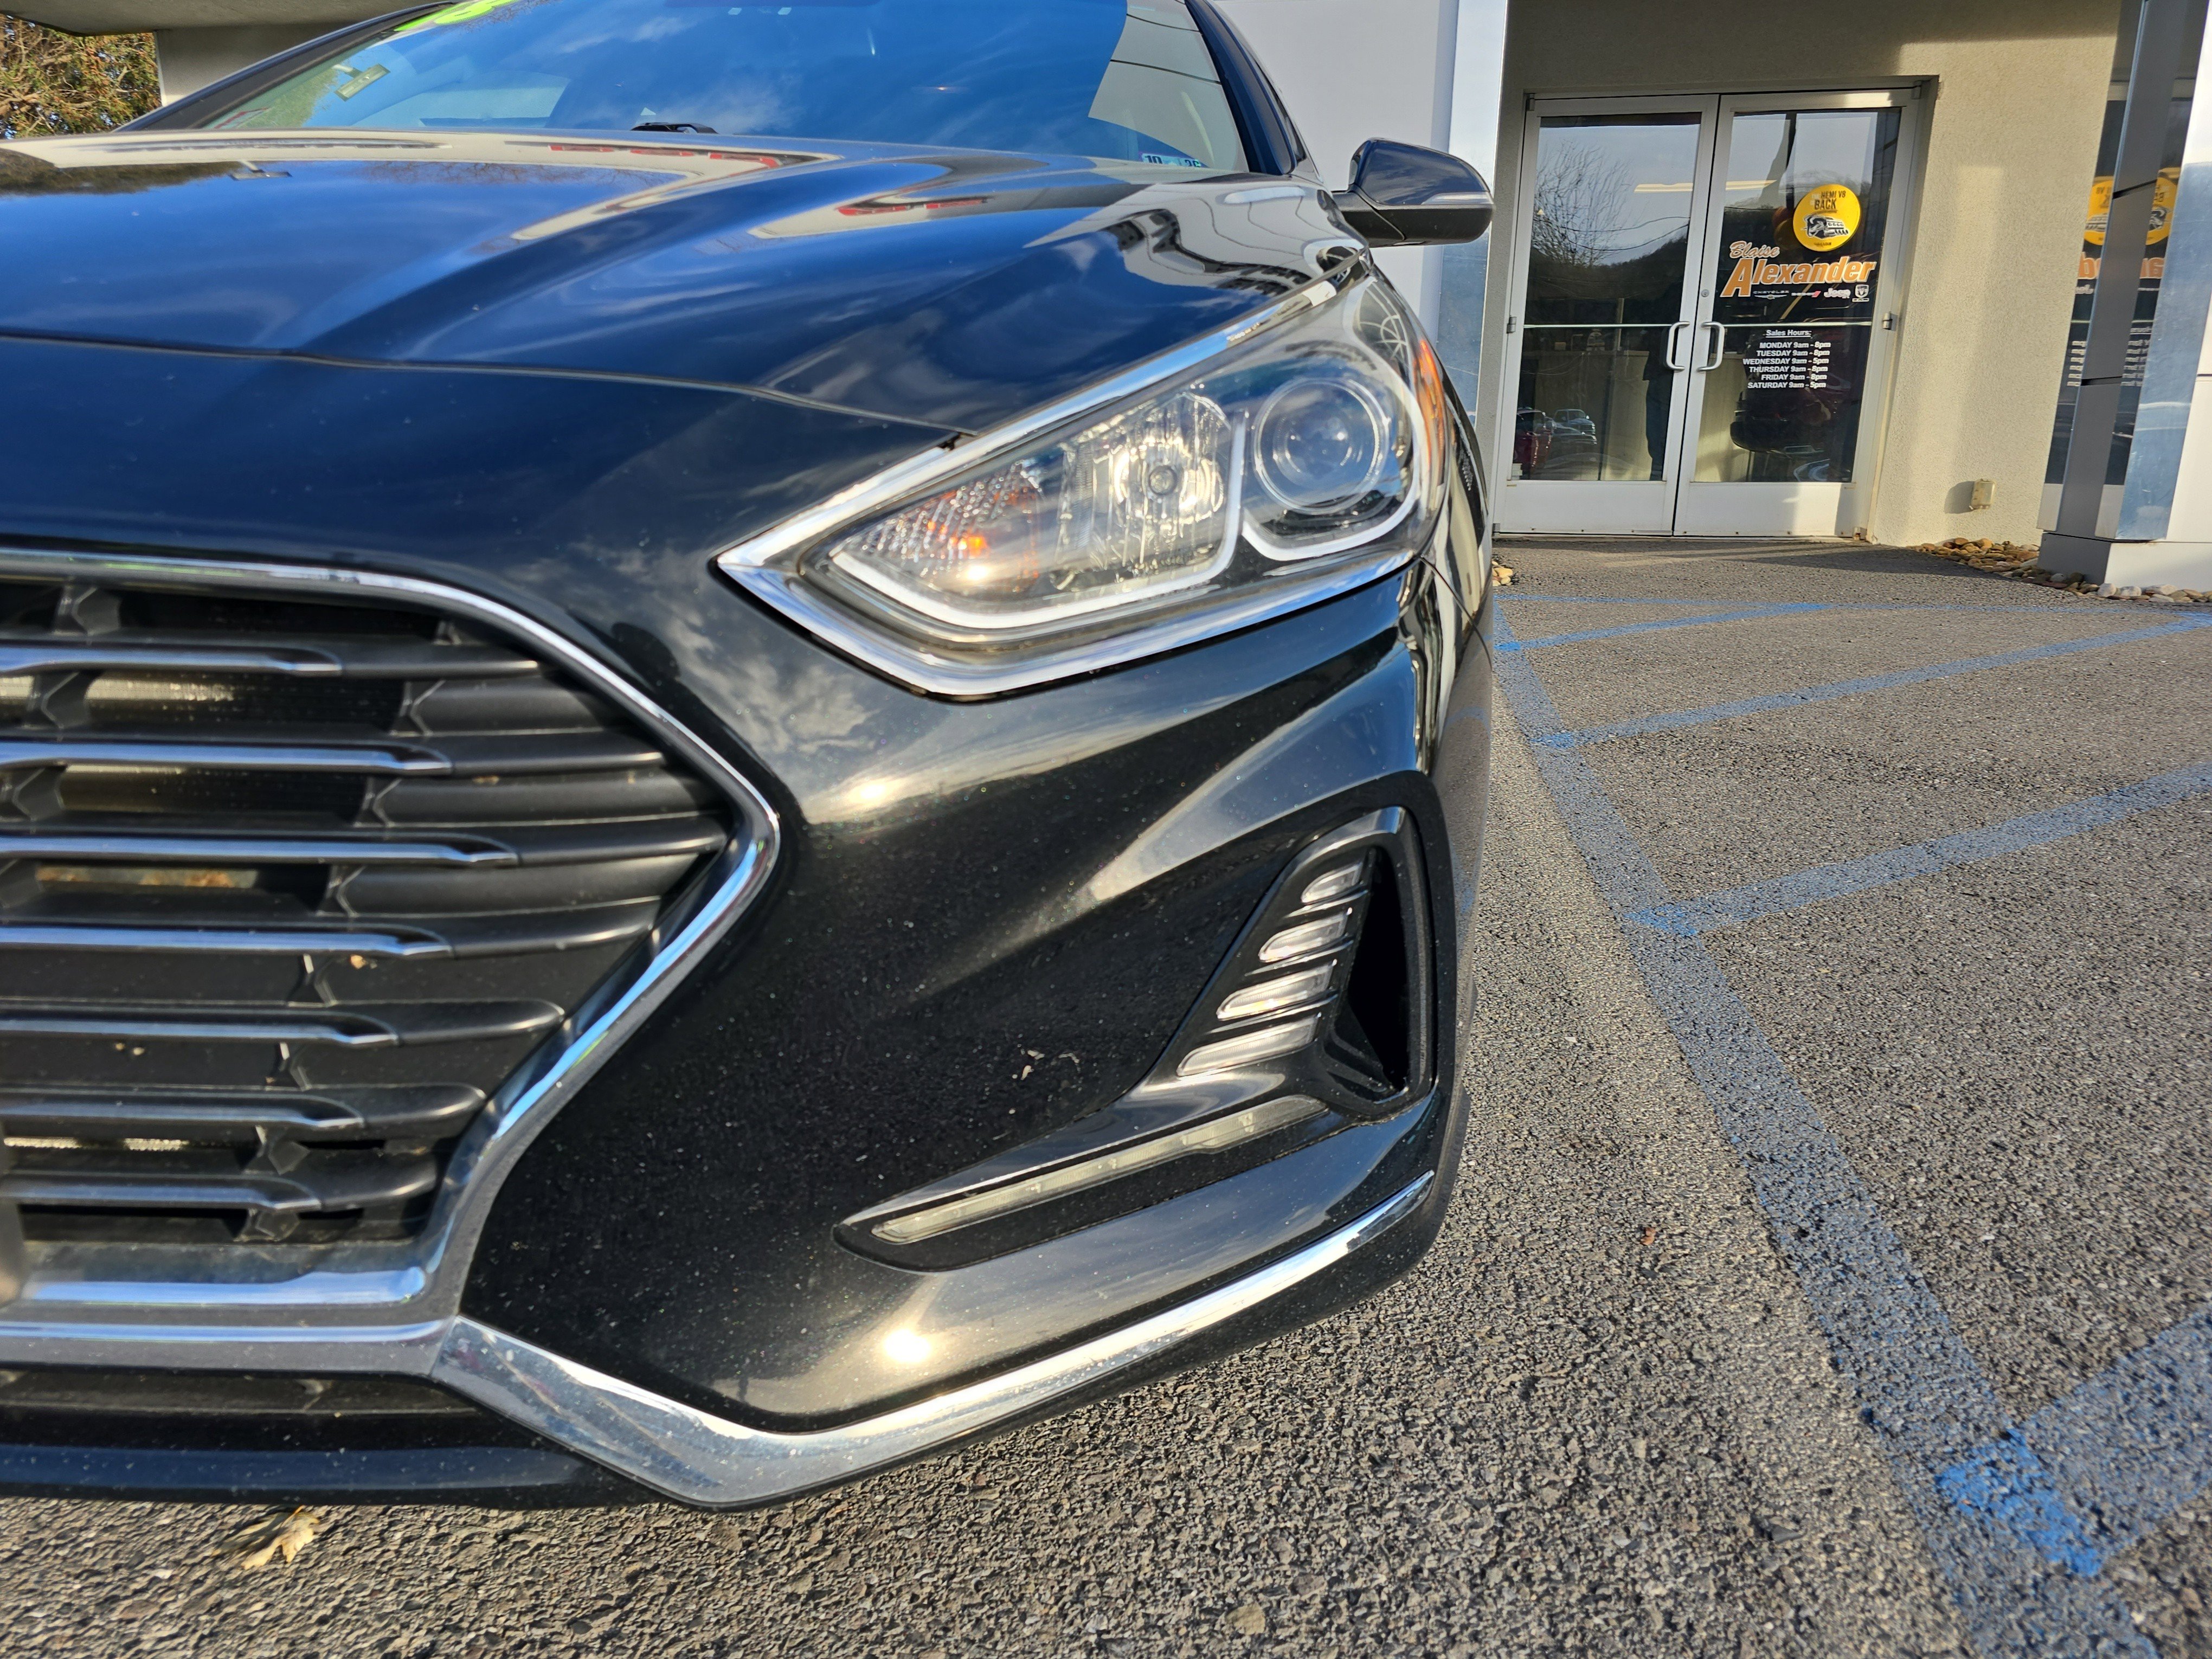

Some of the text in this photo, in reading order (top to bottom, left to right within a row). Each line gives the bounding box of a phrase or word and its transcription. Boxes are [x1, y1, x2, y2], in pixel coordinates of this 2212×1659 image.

[1838, 190, 1846, 198] V8
[1814, 198, 1837, 210] BACK
[1729, 241, 1780, 259] Blaise
[1720, 256, 1877, 298] Alexander
[1823, 288, 1851, 298] Jeep
